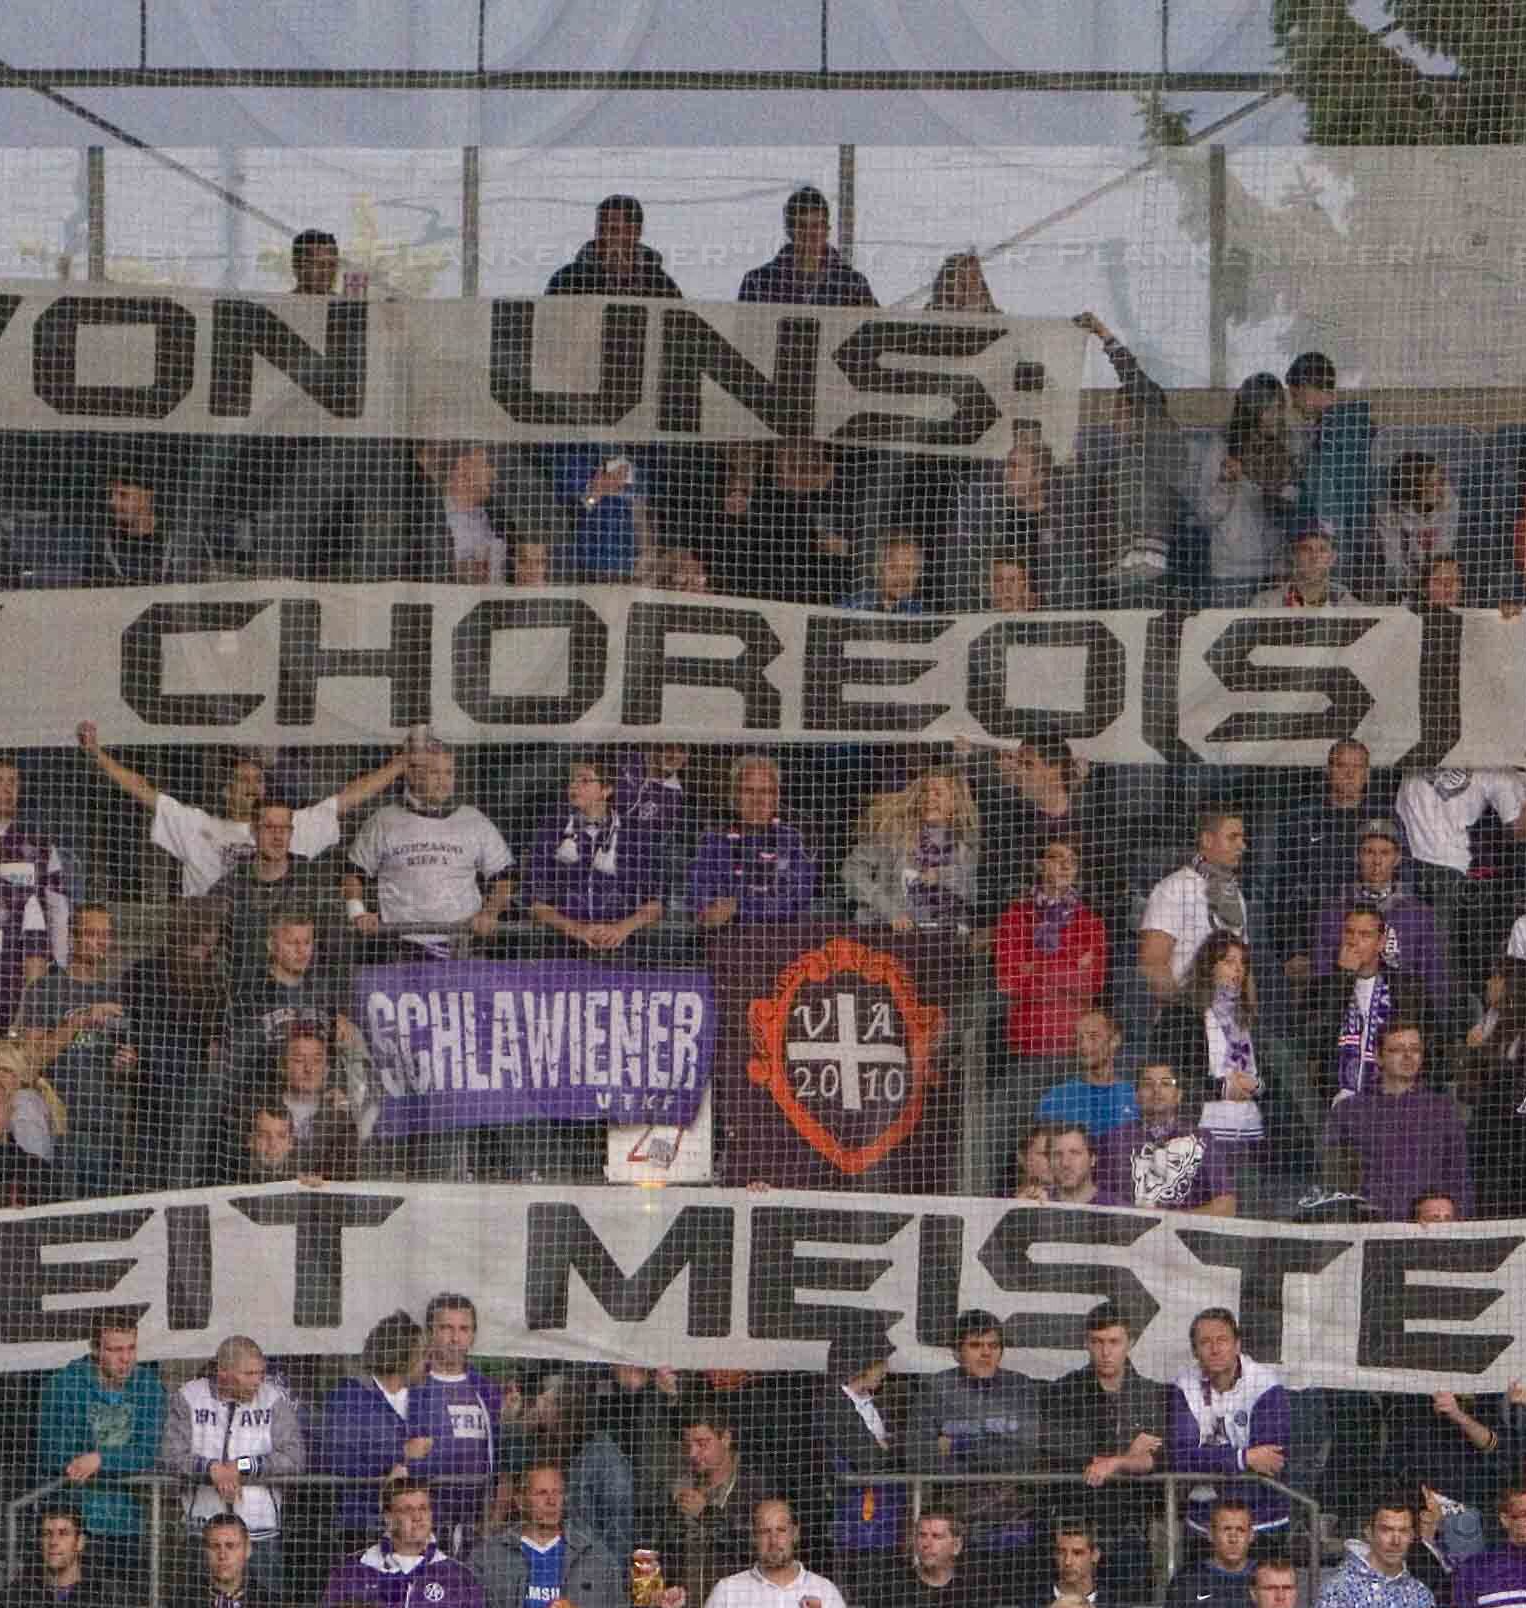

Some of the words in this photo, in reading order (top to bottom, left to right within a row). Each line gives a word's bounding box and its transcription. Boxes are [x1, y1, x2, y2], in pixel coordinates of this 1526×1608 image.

[490, 299, 1047, 446] UNS:
[120, 597, 1464, 767] CHOREO(S)
[367, 990, 704, 1096] SCHLAWIENER
